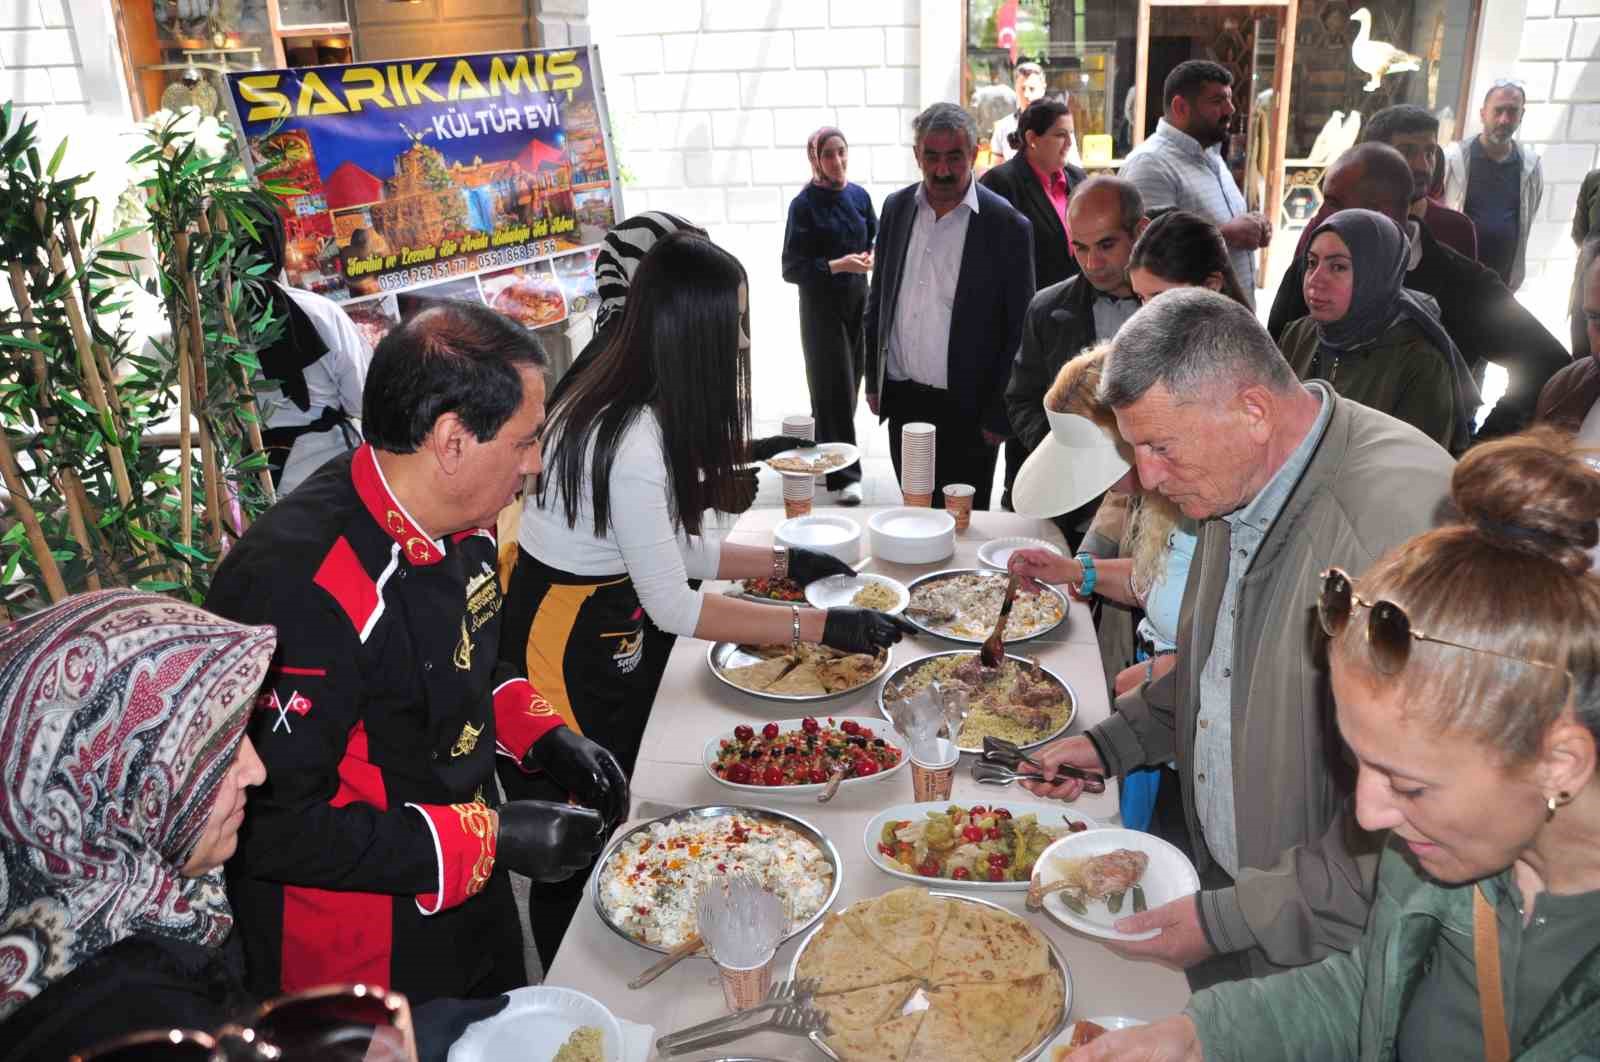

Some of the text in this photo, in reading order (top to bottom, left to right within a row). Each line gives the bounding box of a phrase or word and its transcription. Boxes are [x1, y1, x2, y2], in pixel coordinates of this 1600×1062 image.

[238, 51, 583, 121] SARIKAMIŞ
[432, 97, 560, 140] KÜLTÜR EVİ
[378, 271, 409, 290] 0536
[410, 264, 433, 285] 262
[435, 260, 449, 279] 51
[450, 257, 466, 275] 77
[505, 244, 527, 263] 868
[527, 240, 542, 258] 55
[543, 238, 556, 255] 56
